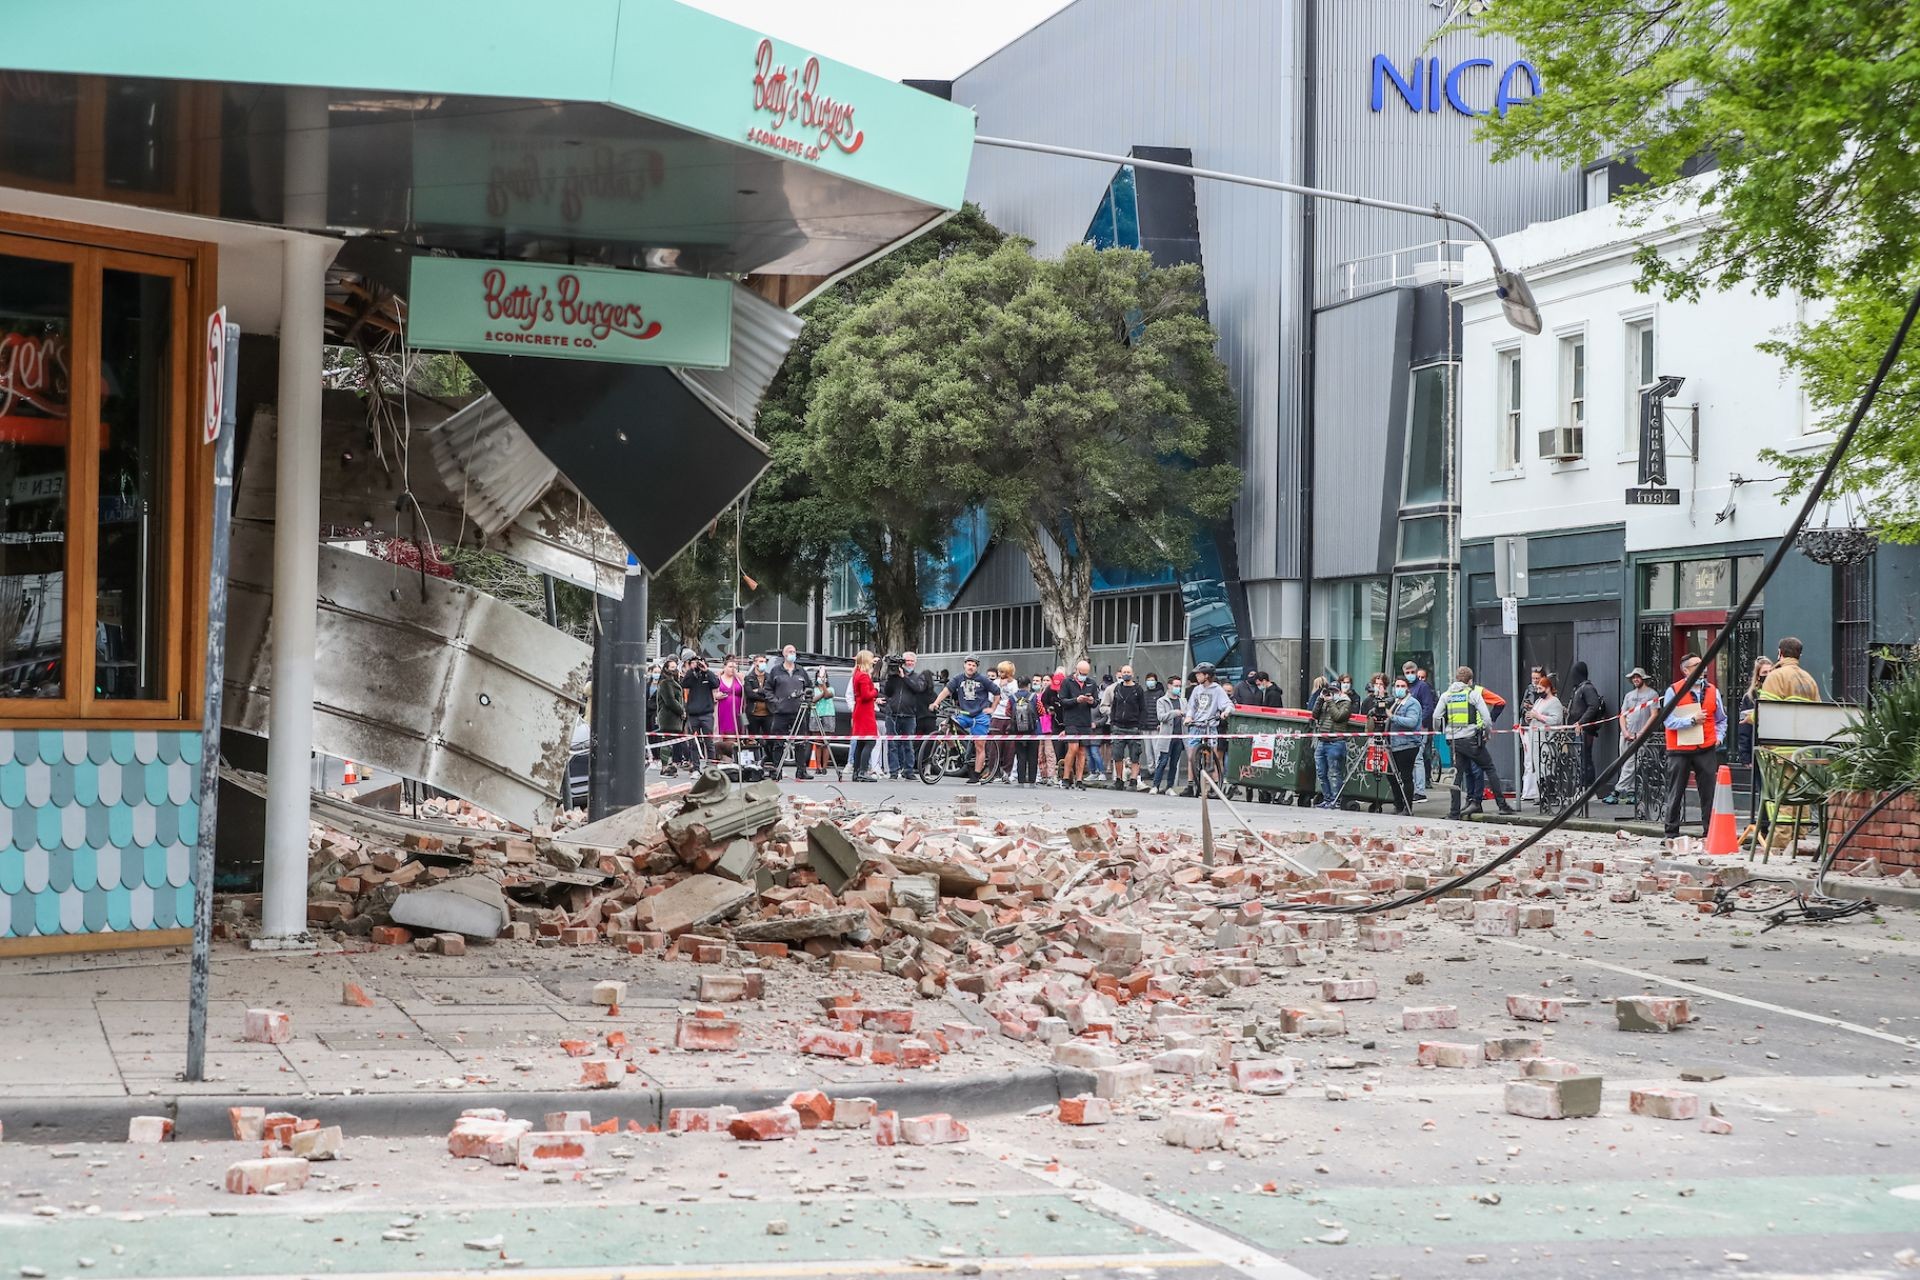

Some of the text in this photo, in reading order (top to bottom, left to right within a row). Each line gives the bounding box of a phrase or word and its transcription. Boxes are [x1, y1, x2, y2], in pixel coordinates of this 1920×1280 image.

[754, 38, 864, 154] Betty's Burgers
[1371, 54, 1543, 119] NICA
[756, 129, 803, 156] CONCRETE
[484, 269, 662, 340] Betty's Burgers
[494, 331, 569, 347] CONCRETE
[573, 337, 597, 349] CO.
[1637, 490, 1673, 504] tusk
